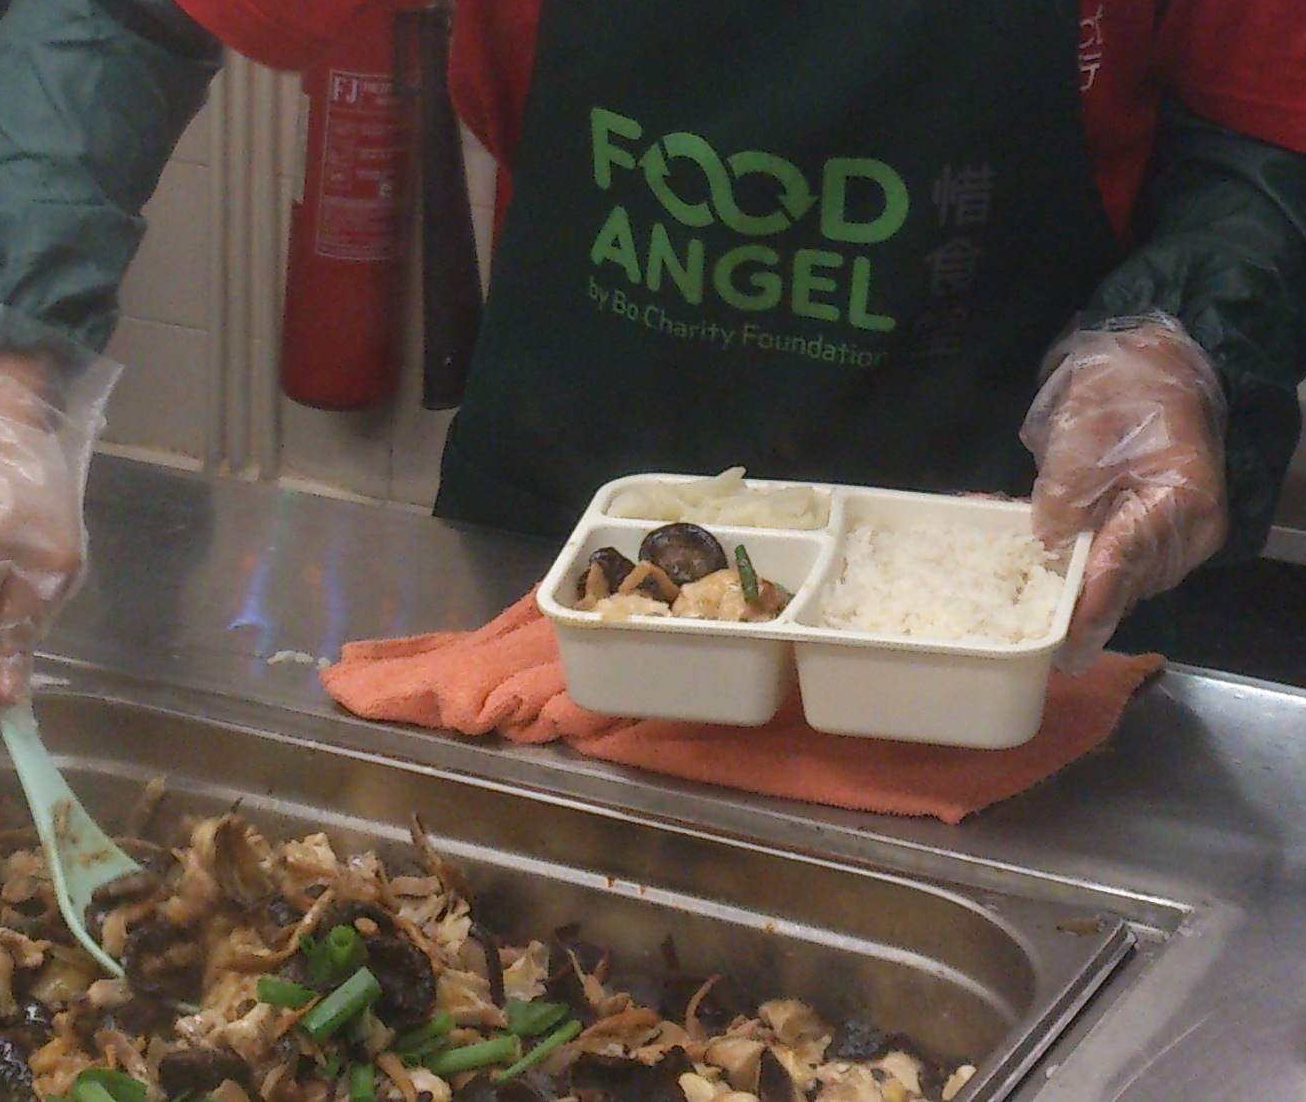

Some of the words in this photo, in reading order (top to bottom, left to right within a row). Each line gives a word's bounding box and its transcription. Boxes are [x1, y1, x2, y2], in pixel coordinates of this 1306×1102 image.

[590, 106, 910, 245] FOOD
[588, 275, 608, 310] by
[612, 289, 639, 320] Bo
[642, 304, 737, 350] Charity
[590, 205, 896, 332] ANGEL
